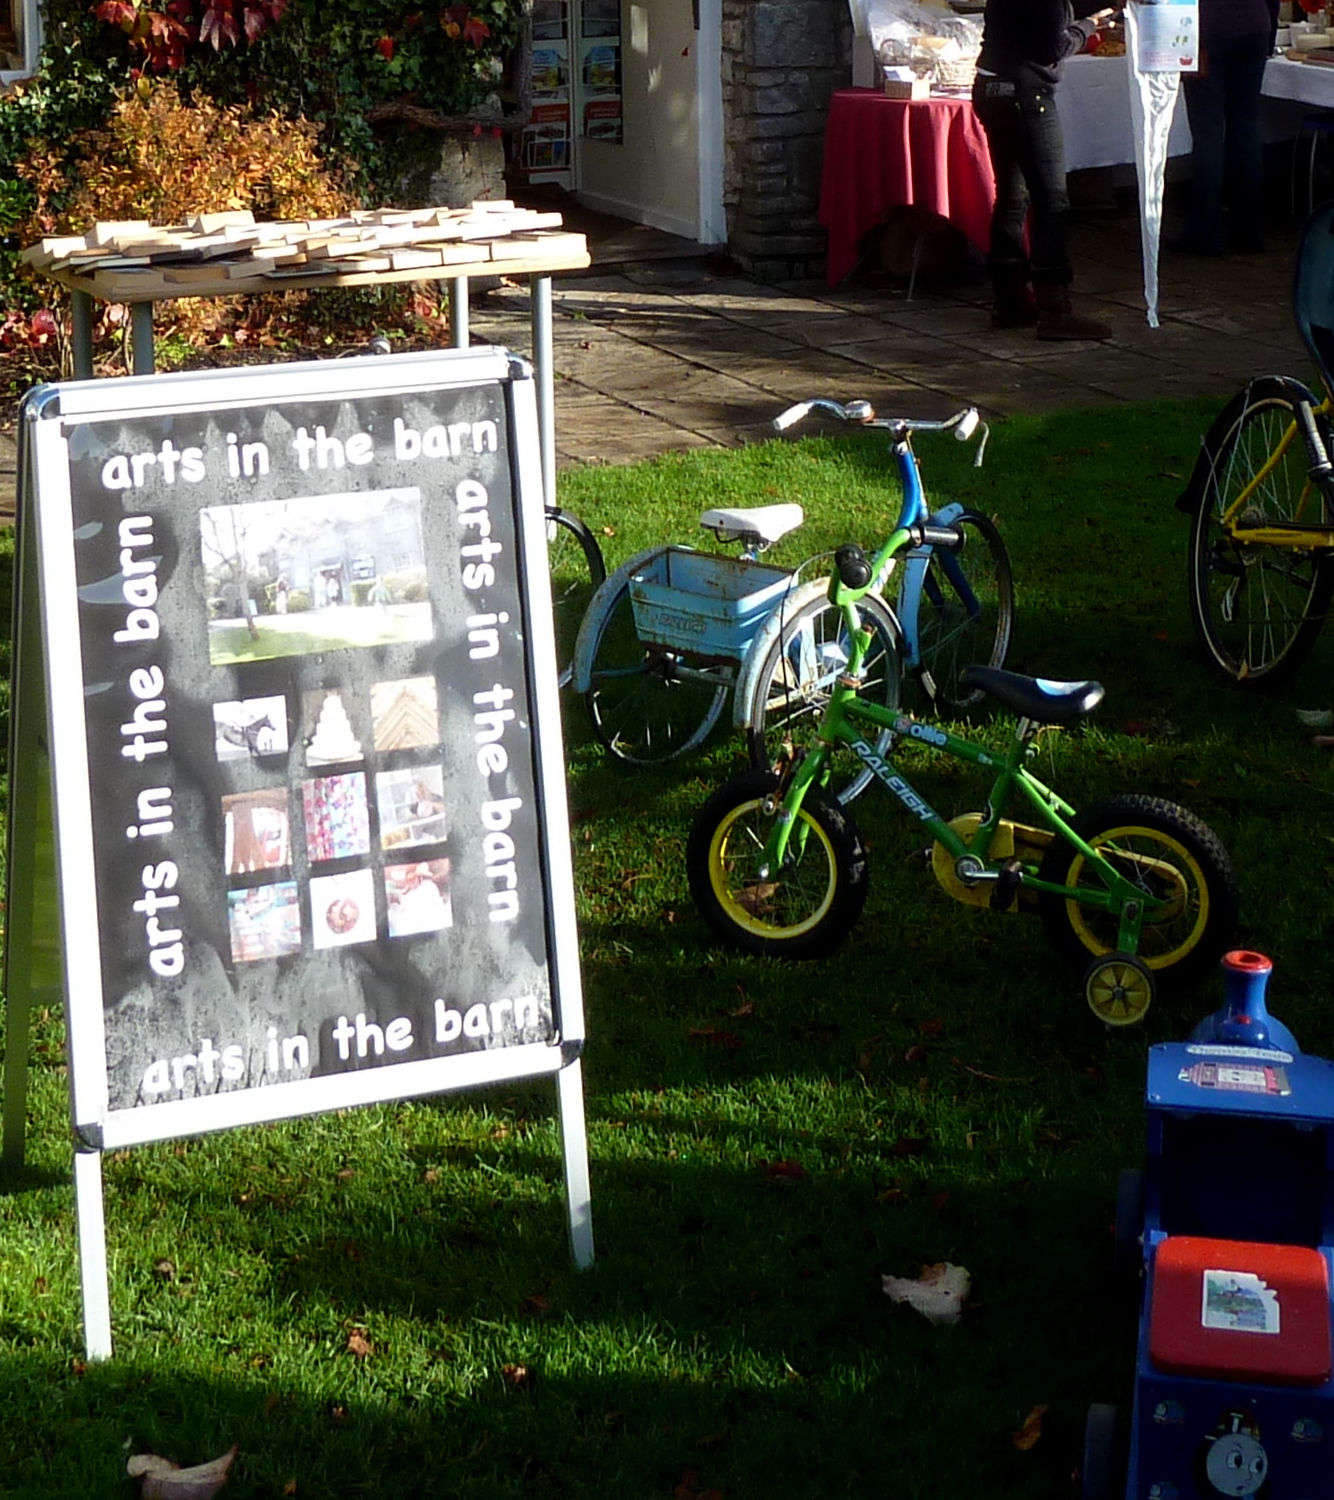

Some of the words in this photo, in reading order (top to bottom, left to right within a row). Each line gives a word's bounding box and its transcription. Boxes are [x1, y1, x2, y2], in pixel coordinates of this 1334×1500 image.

[102, 439, 206, 489] arts
[227, 433, 269, 477] in
[293, 425, 374, 471] the
[394, 417, 498, 460] barn
[113, 514, 161, 643] barn
[455, 478, 503, 590] arts
[466, 611, 509, 660] in
[120, 665, 169, 762] the
[473, 683, 516, 777] the
[126, 786, 175, 839] in
[851, 740, 935, 821] RALEIGH
[481, 797, 523, 923] barn
[133, 859, 185, 978] arts
[143, 1038, 245, 1093] arts
[267, 1027, 310, 1073] in
[332, 1013, 414, 1060] the
[434, 995, 539, 1043] barn
